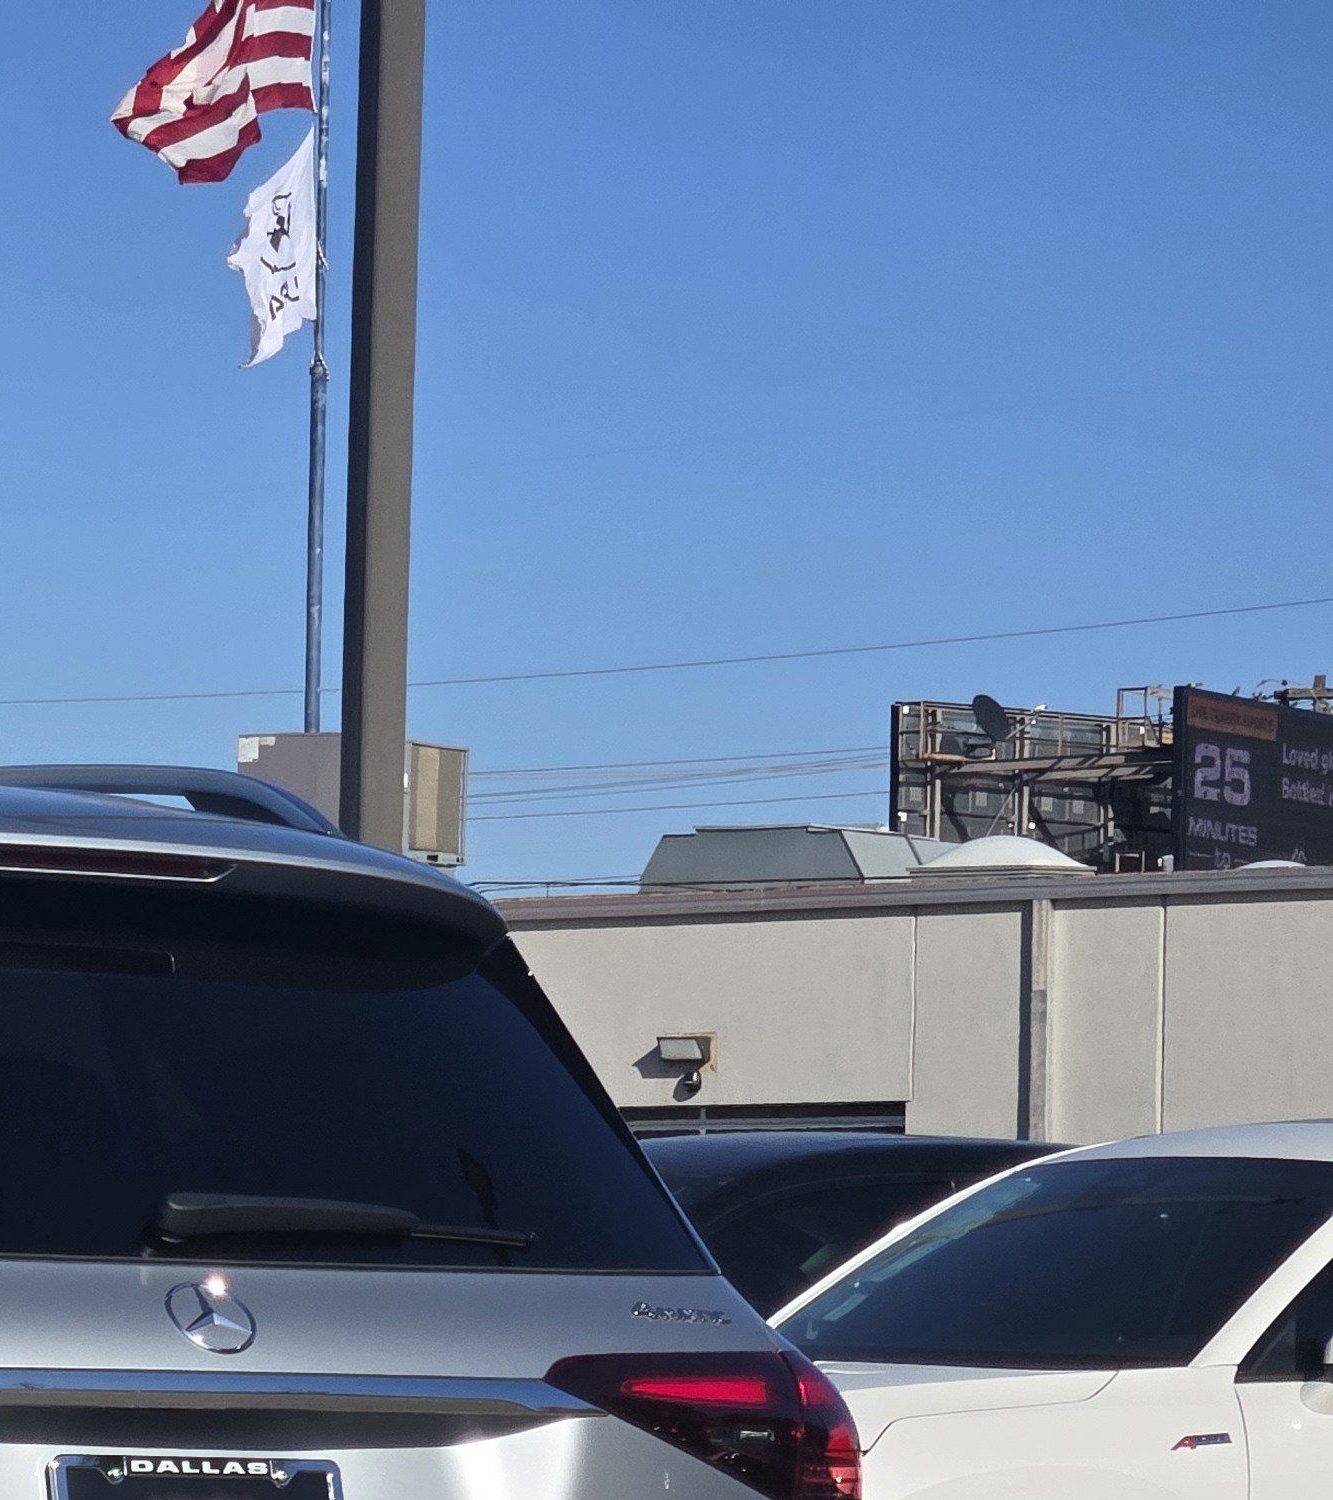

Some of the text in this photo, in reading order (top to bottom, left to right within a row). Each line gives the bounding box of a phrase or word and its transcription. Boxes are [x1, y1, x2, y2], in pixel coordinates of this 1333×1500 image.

[1194, 743, 1251, 806] 25
[1188, 817, 1258, 847] MINUTES
[130, 1460, 269, 1475] DALLAS
